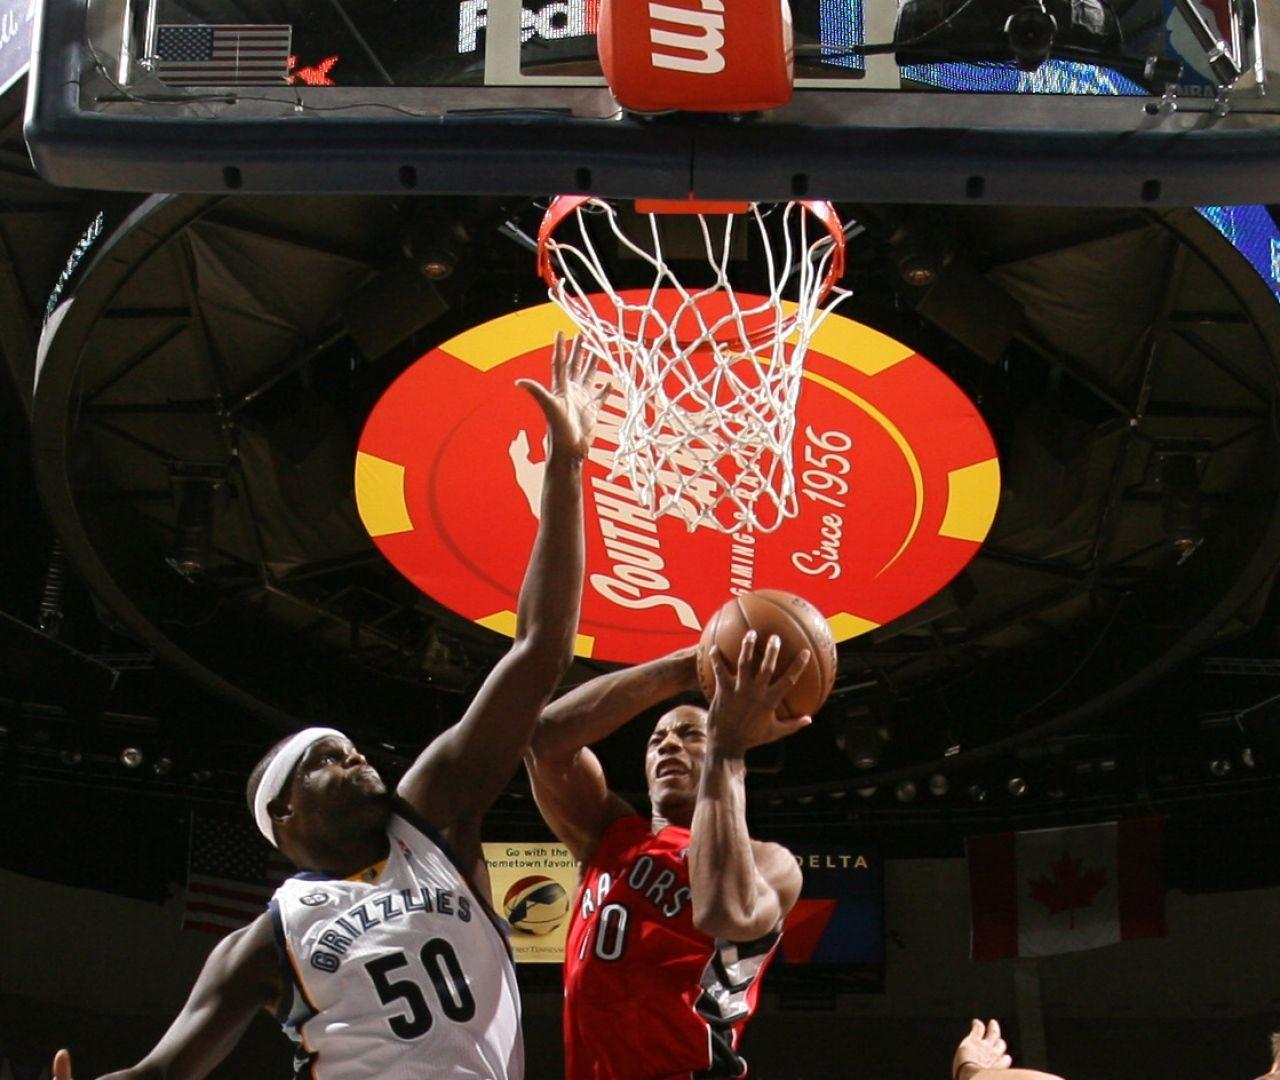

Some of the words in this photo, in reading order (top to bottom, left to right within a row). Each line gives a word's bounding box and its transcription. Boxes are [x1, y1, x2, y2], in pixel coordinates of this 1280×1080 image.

[801, 425, 852, 508] 1956
[729, 532, 756, 599] GAMING
[791, 514, 843, 580] Since
[506, 848, 520, 857] Go
[524, 847, 547, 857] with
[551, 848, 568, 857] the
[310, 886, 472, 975] GRIZZLIES
[364, 935, 477, 1042] 50
